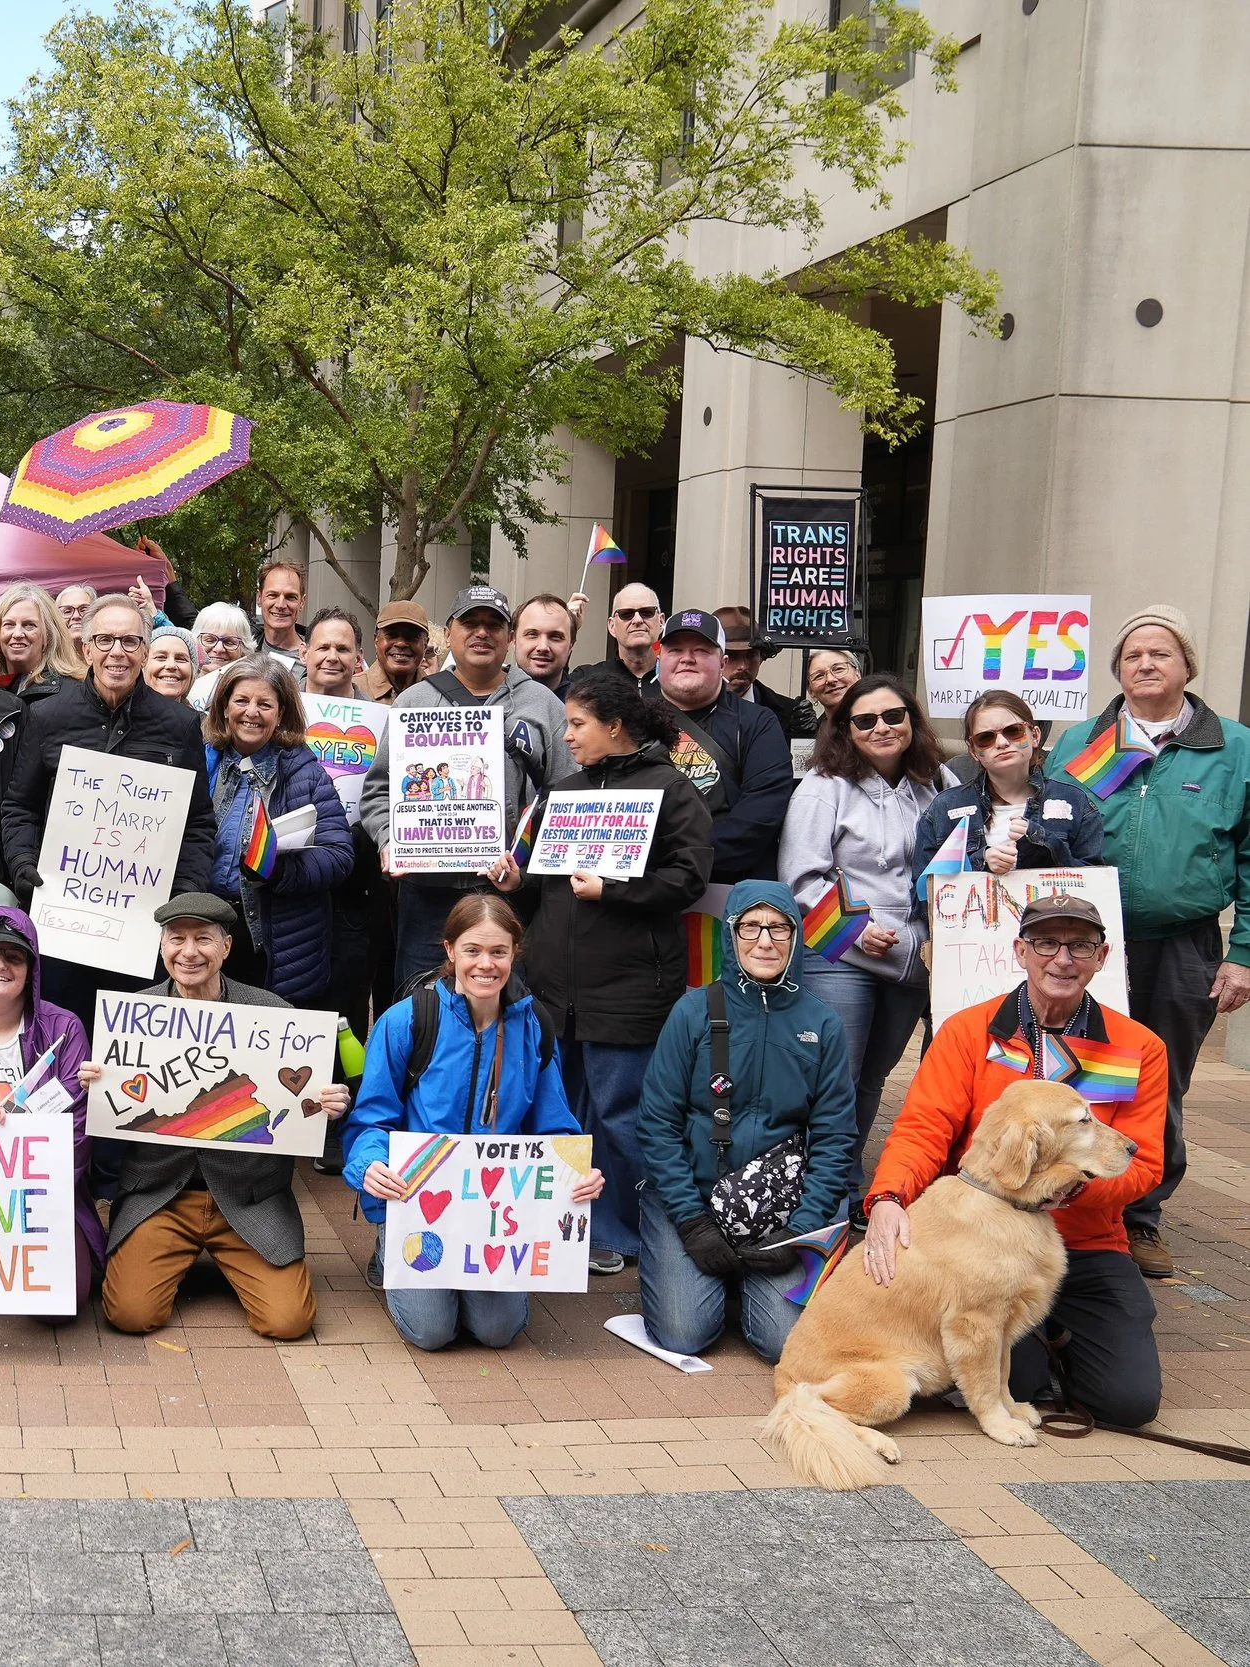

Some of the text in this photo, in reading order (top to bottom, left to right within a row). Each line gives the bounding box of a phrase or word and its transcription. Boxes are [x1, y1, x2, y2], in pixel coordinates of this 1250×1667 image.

[773, 525, 846, 545] TRANS
[772, 547, 845, 565] RIGHTS
[789, 567, 830, 585] ARE
[771, 589, 844, 607] HUMAN
[769, 608, 843, 627] RIGHTS
[972, 610, 1089, 680] YES
[1020, 690, 1088, 710] EQUALITY
[317, 703, 363, 723] VOTE
[400, 710, 491, 722] CATHOLICS CAN
[407, 721, 483, 733] SAY YES TO
[405, 732, 489, 747] EQUALITY
[509, 719, 533, 756] A
[314, 740, 366, 765] YES
[67, 768, 173, 802] THE RIGHT
[65, 797, 166, 832] TO MARRY
[396, 805, 416, 813] JESUS
[549, 802, 655, 814] TRUST WOMEN & FAMILIES.
[444, 818, 453, 826] IS
[455, 818, 476, 826] WHY
[548, 815, 649, 828] EQUALITY FOR ALL.
[92, 827, 147, 854] IS A
[398, 826, 499, 841] I HAVE VOTED YES.
[541, 829, 648, 840] RESTORE VOTING RIGHTS.
[552, 844, 642, 854] YES YES YES
[59, 845, 161, 887] HUMAN
[63, 878, 135, 908] RIGHT
[70, 921, 90, 933] ON
[95, 920, 111, 936] 2
[102, 998, 326, 1058] VIRGINIA is for
[103, 1039, 150, 1068] ALL
[475, 1140, 544, 1160] VOTE YES
